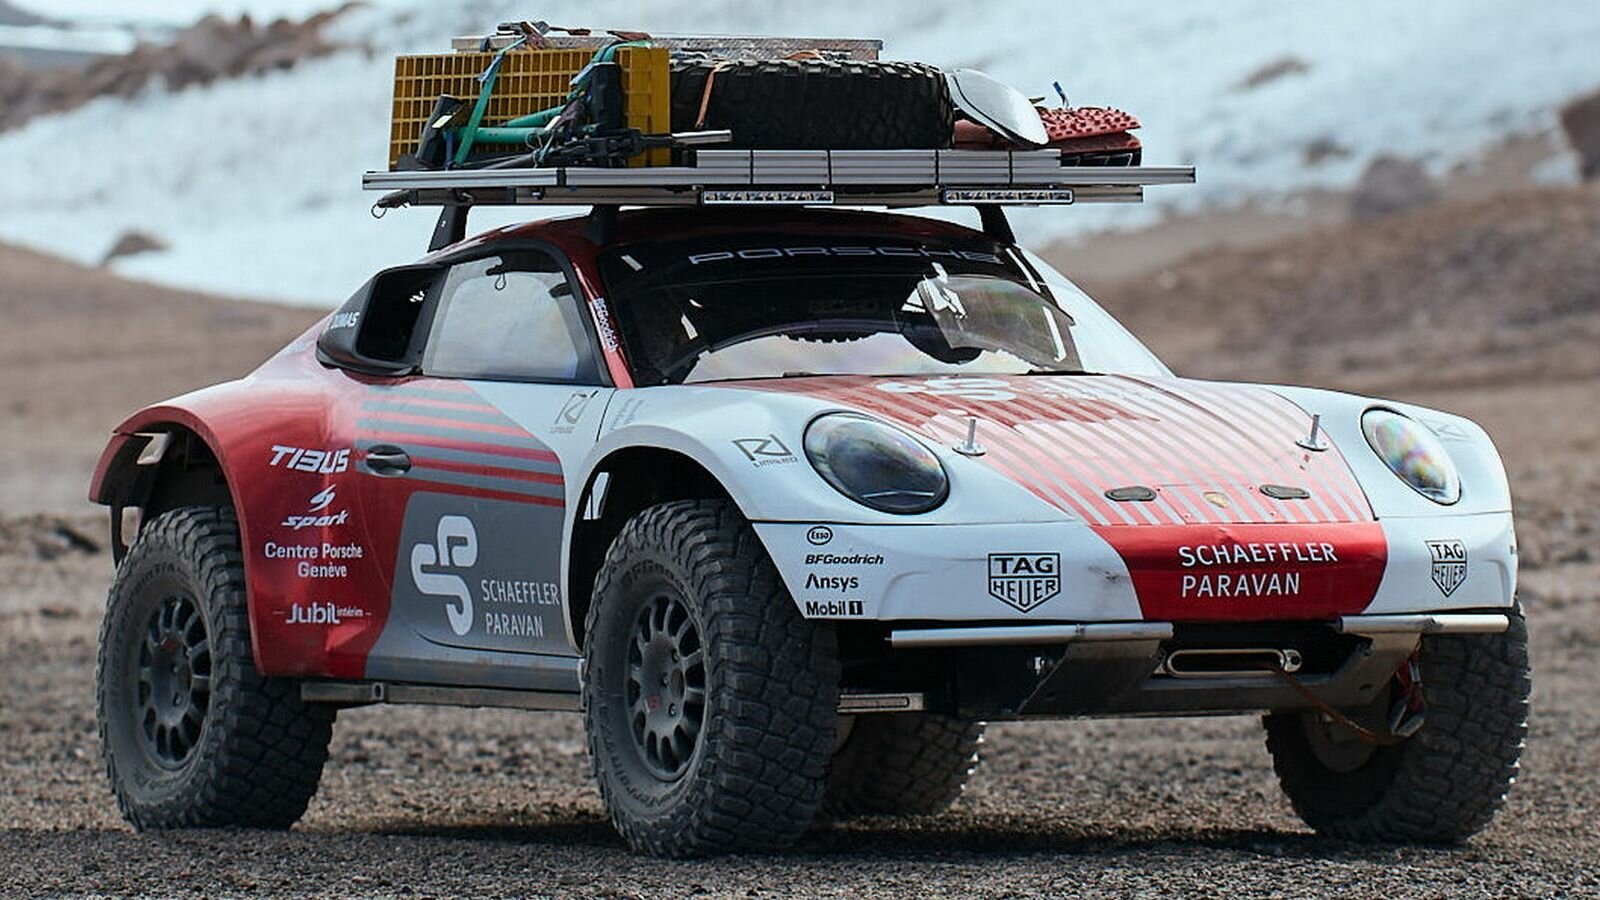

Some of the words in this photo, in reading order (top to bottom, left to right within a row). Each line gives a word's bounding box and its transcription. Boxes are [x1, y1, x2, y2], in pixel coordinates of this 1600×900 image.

[688, 246, 1004, 265] PORSCHE
[265, 542, 318, 559] Centre
[322, 542, 363, 559] Porsche
[805, 554, 884, 565] BFGoodrich
[1178, 542, 1338, 567] SCHAEFFLER
[1431, 543, 1464, 559] TAG
[298, 561, 347, 578] Genève
[994, 557, 1053, 574] TAG
[805, 572, 858, 593] Ansys
[1182, 573, 1300, 597] PARAVAN
[1434, 565, 1464, 592] HEUER
[481, 579, 560, 605] SCHAEFFLER
[993, 580, 1056, 607] HEUER
[806, 601, 846, 615] Mobil
[485, 612, 544, 637] PARAVAN
